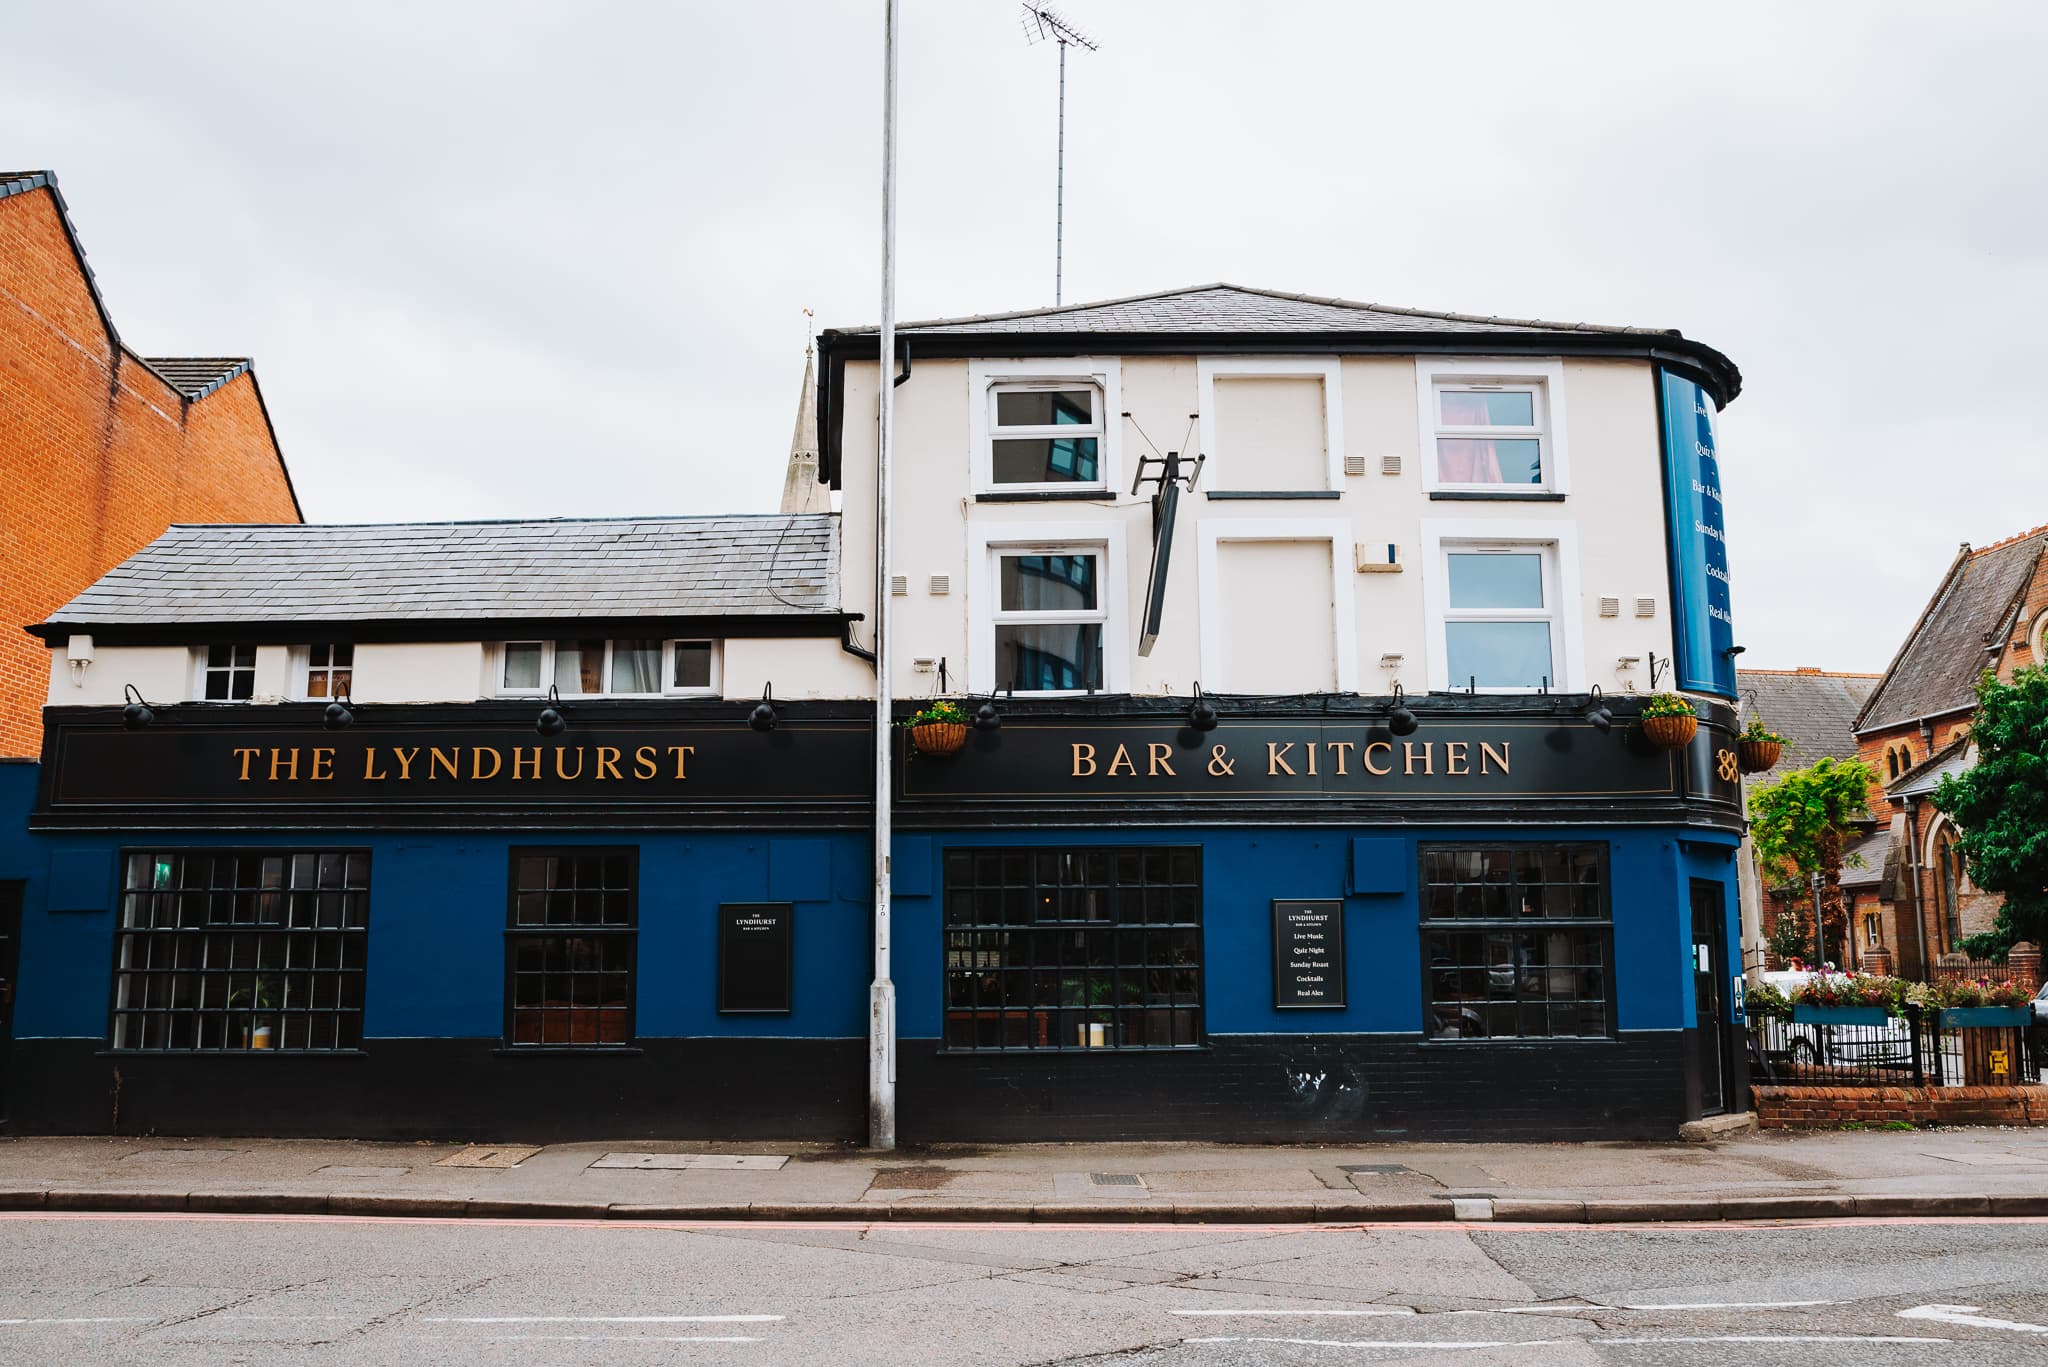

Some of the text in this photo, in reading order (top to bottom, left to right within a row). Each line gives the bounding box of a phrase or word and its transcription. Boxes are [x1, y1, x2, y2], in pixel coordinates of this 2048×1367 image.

[1695, 440, 1711, 457] Quiz
[1692, 479, 1705, 494] Bar
[1695, 519, 1719, 541] Sunday
[1708, 604, 1723, 620] Real
[234, 746, 695, 780] THE LYNDHURST
[1071, 741, 1511, 777] BAR & KITCHEN
[1717, 748, 1739, 784] 88
[1293, 947, 1325, 955] Quiz Night
[1290, 961, 1311, 969] Sunday
